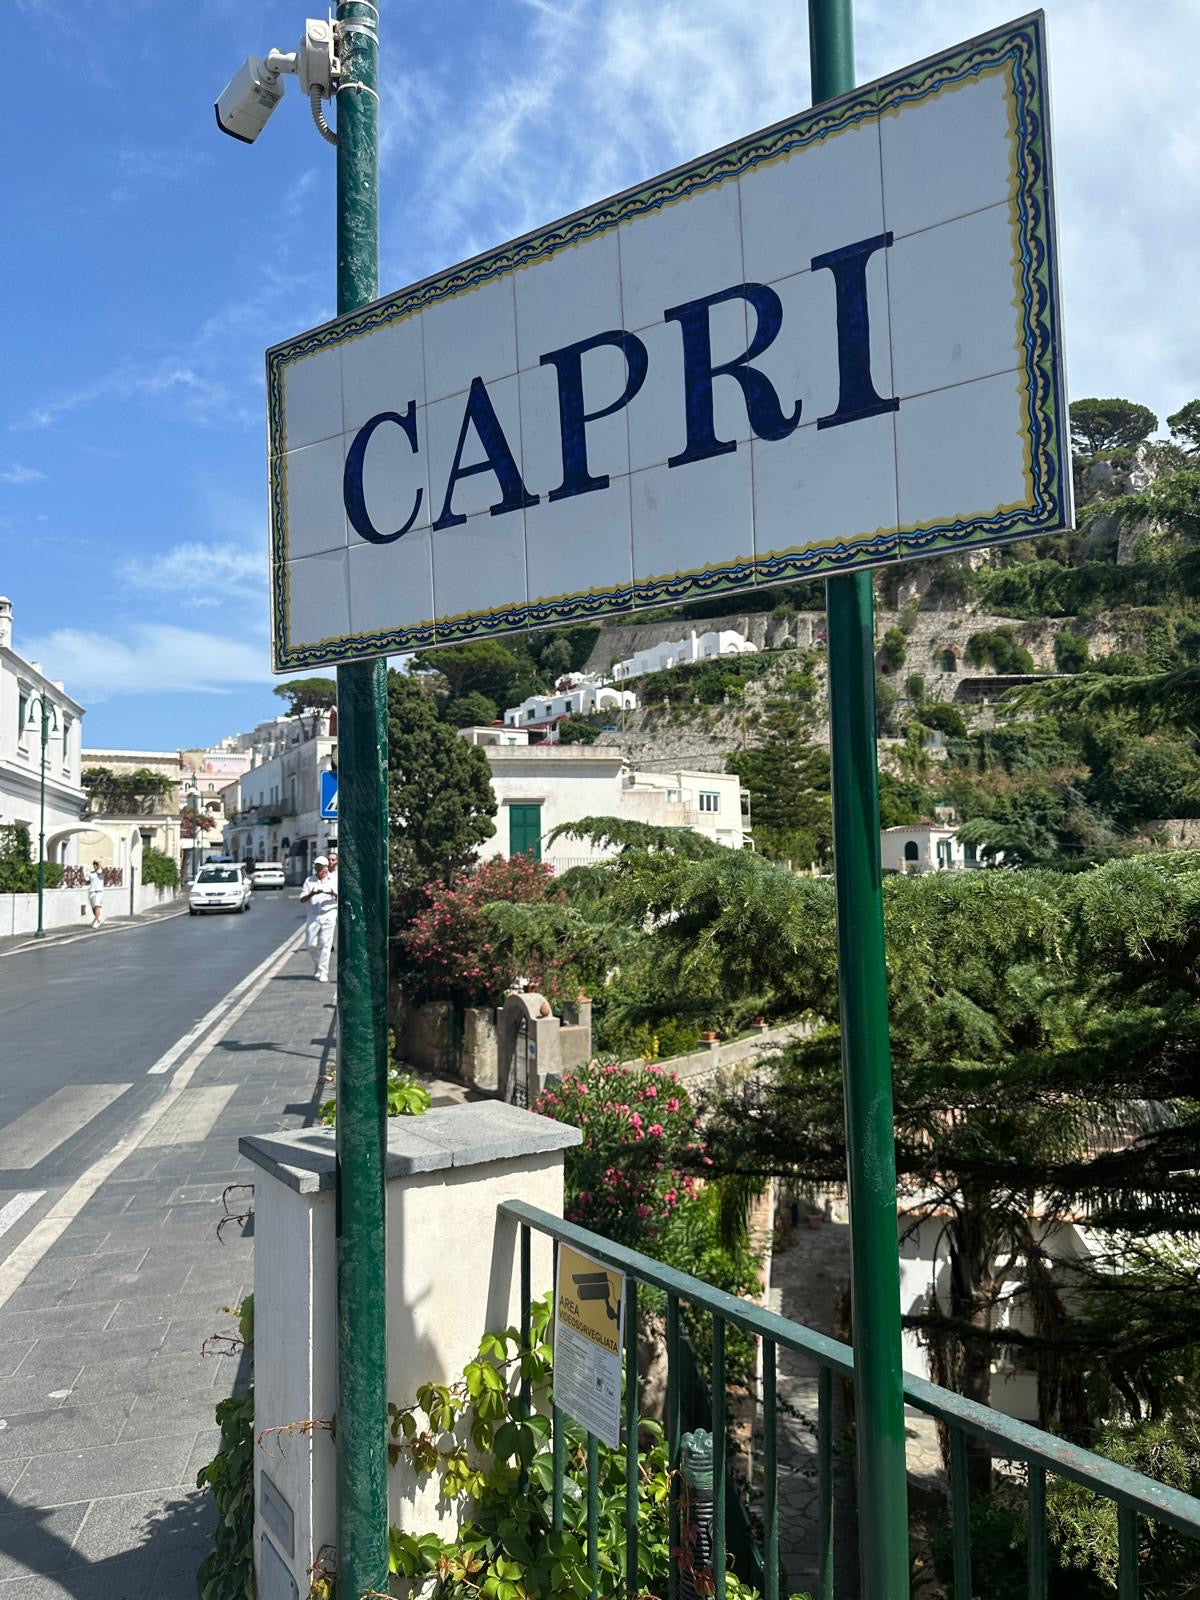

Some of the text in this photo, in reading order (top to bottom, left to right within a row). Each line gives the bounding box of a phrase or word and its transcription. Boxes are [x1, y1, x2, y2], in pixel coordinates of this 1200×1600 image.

[343, 231, 899, 545] CAPRI
[559, 1295, 580, 1317] AREA
[559, 1309, 619, 1353] VIDEOSORVEGLIATA
